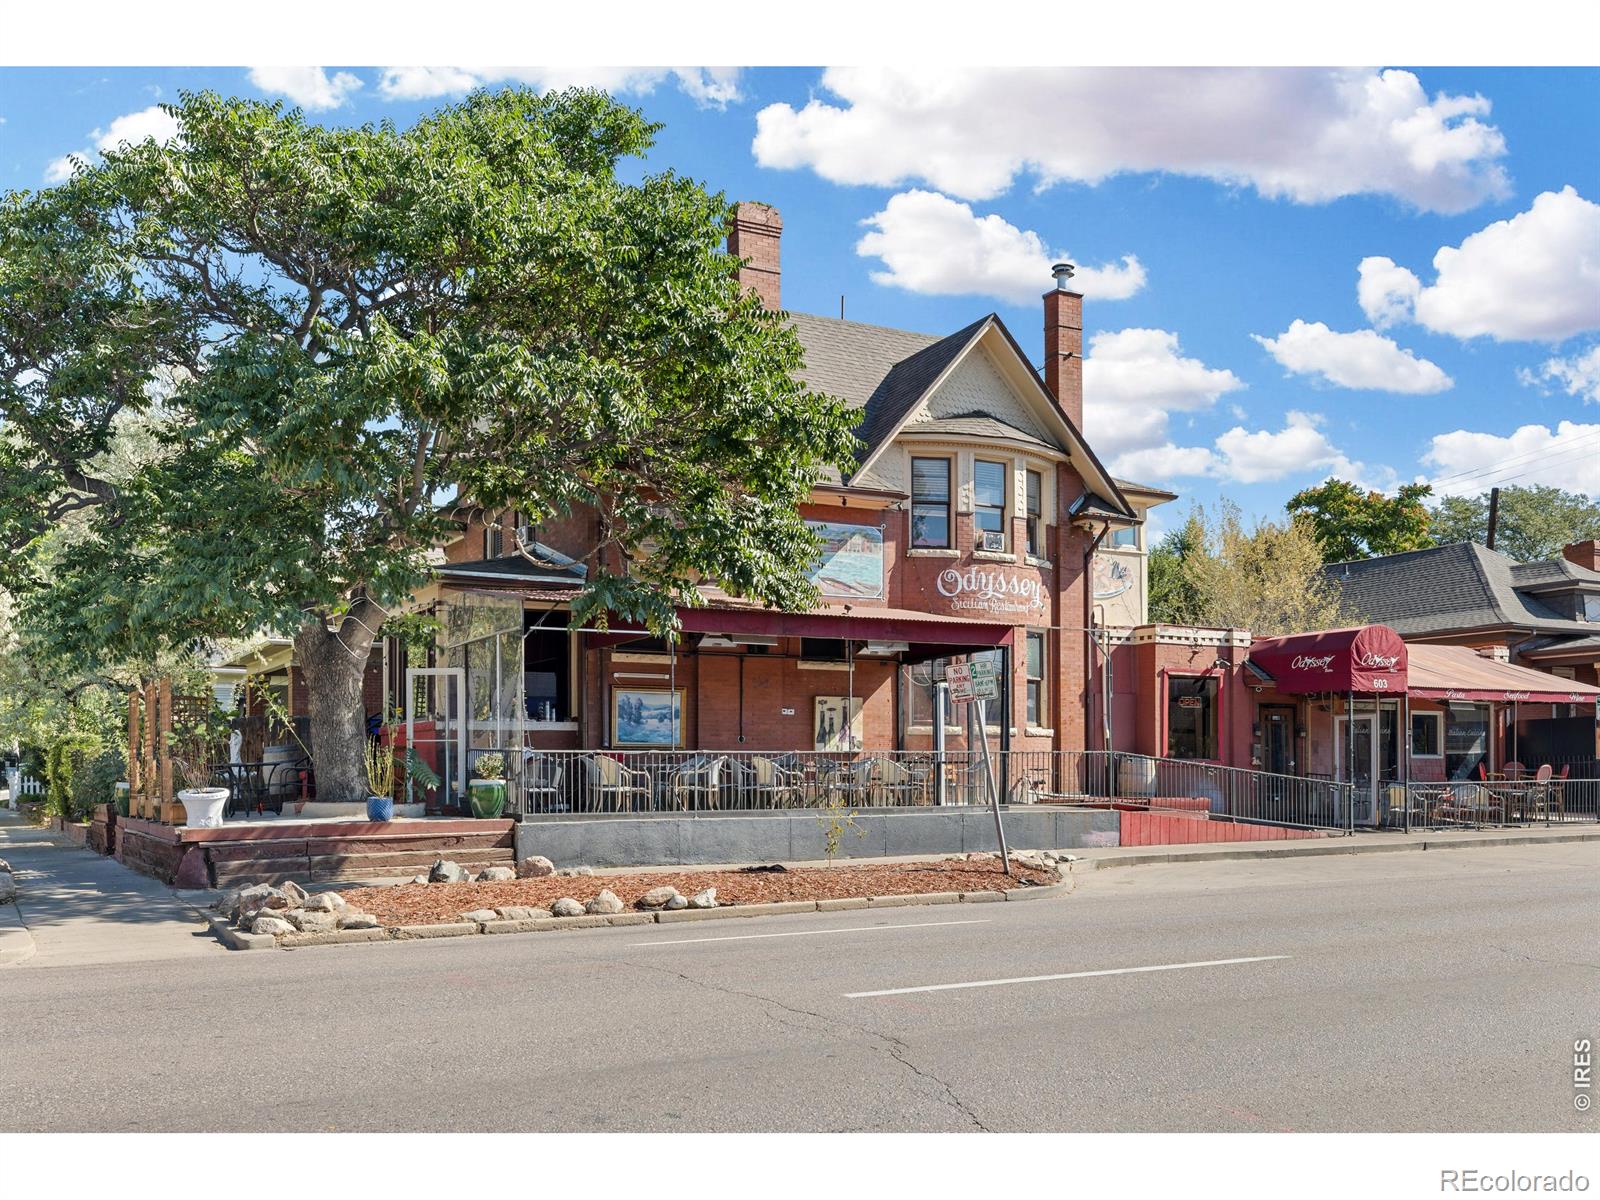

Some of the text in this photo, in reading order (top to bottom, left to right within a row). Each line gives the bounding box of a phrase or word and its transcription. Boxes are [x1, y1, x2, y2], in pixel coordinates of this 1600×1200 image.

[937, 567, 1043, 609] Odyssey
[951, 597, 989, 611] Sicilian
[1291, 655, 1335, 671] Odyssey
[1361, 652, 1399, 668] Odyssey
[949, 675, 970, 684] PARKING
[1373, 679, 1388, 689] 603
[1444, 689, 1466, 699] Pasta
[1503, 691, 1530, 701] Seafood
